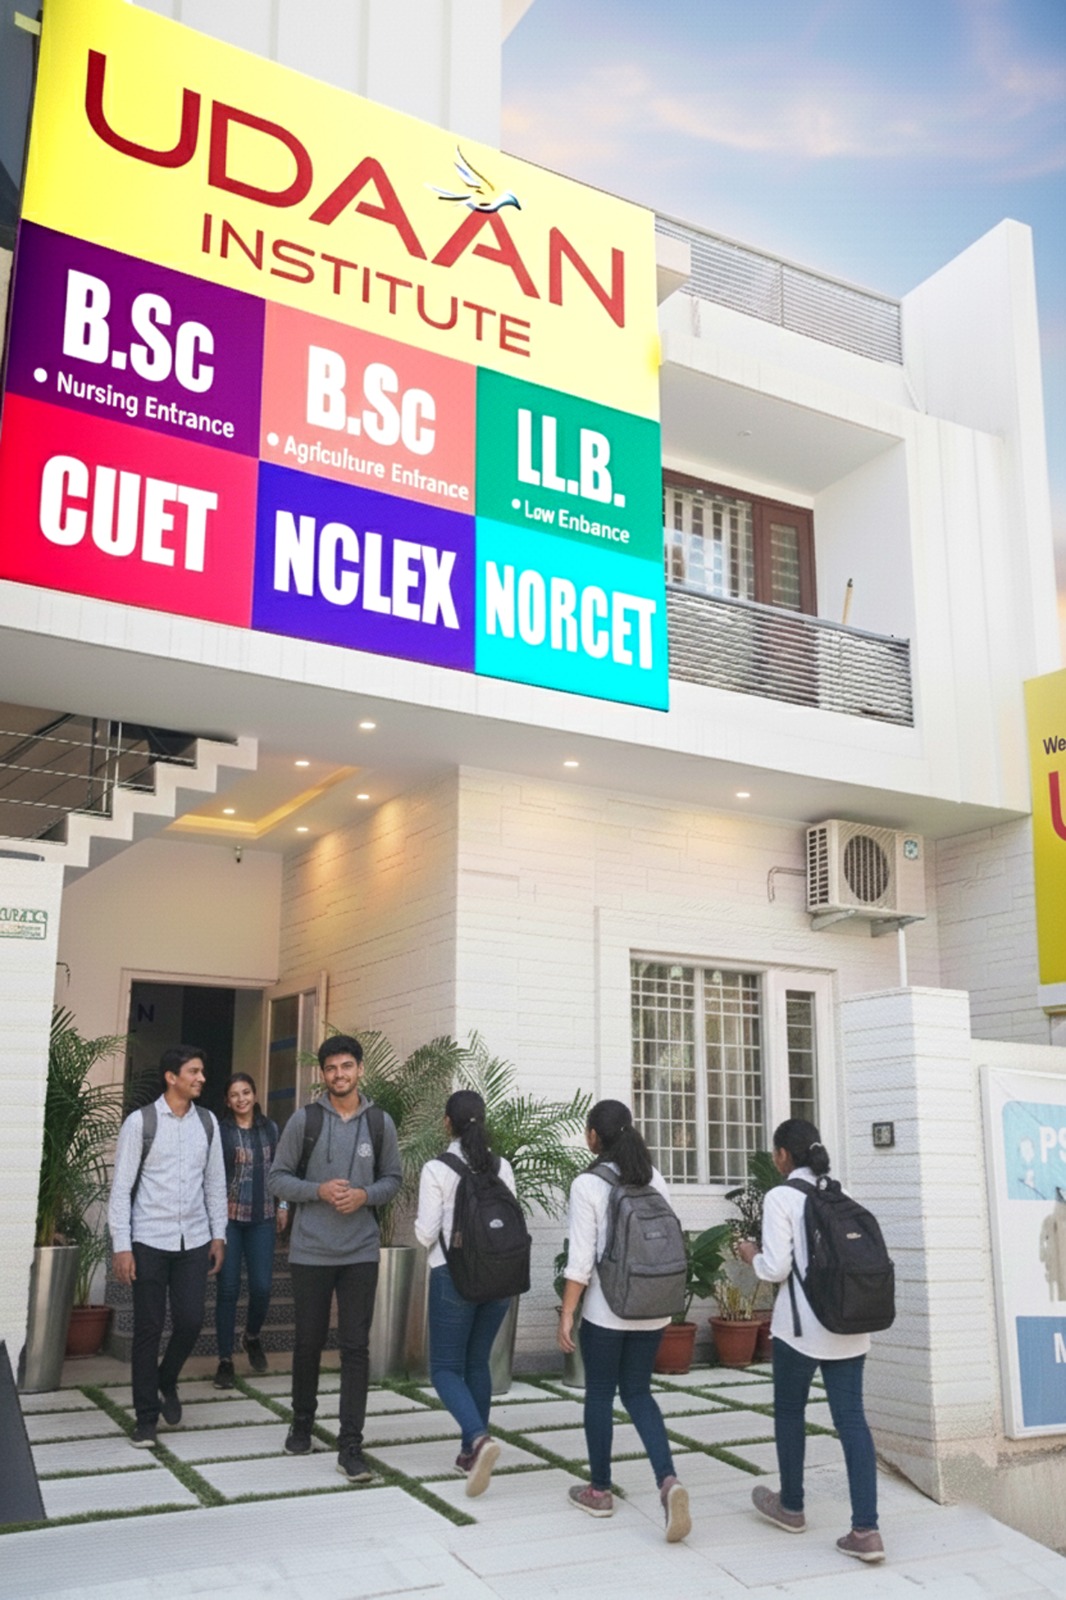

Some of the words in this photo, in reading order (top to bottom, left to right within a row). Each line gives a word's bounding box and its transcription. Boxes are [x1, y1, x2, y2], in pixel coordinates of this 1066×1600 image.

[85, 49, 625, 329] UDAAN
[63, 269, 214, 393] B.Sc
[202, 213, 531, 357] INSTITUTE
[57, 371, 138, 418] Nursing
[145, 396, 235, 438] Entrance
[306, 344, 436, 456] B.Sc
[516, 407, 626, 508] LL.B.
[39, 455, 218, 573] CUET
[274, 510, 460, 630] NCLEX
[486, 561, 656, 670] NORCET
